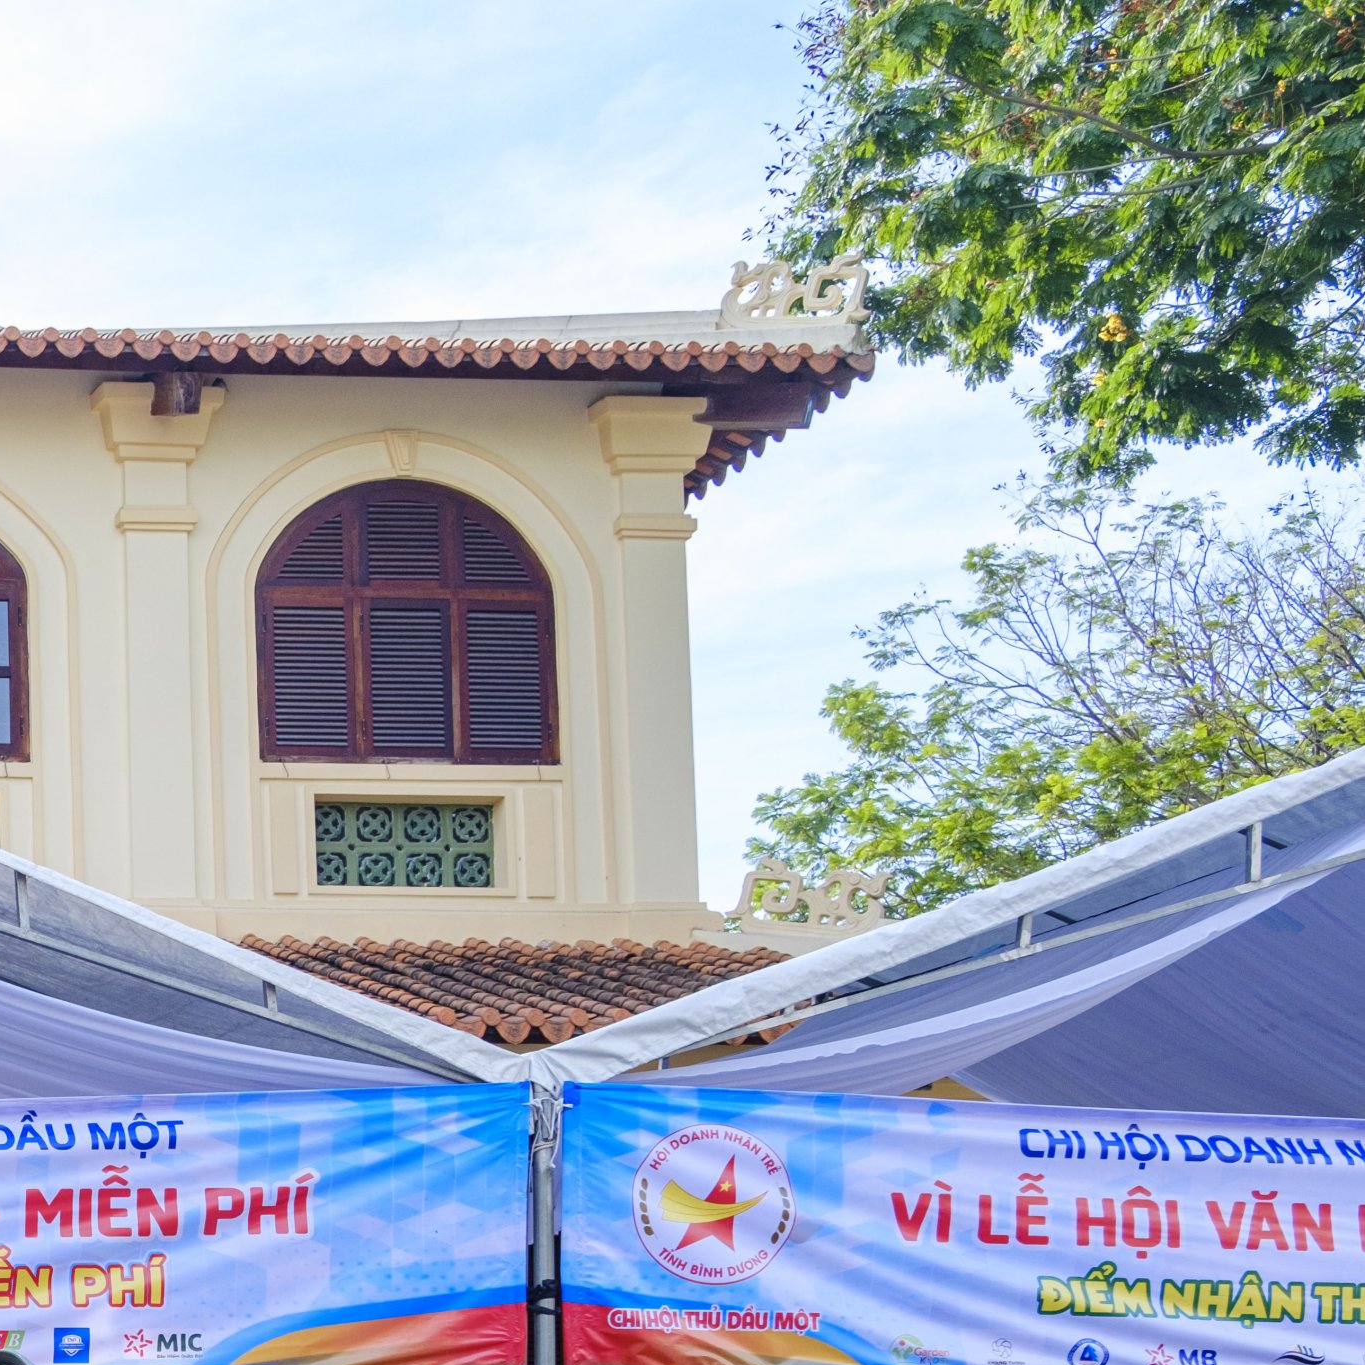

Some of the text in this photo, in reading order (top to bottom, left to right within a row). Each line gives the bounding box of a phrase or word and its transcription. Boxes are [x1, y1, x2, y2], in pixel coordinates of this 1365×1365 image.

[90, 1113, 184, 1159] MỘT
[649, 1128, 784, 1178] HỘI DOANH NHÂN TRẺ
[1020, 1127, 1086, 1160] CHI
[1094, 1123, 1170, 1170] HỘI
[1184, 1133, 1333, 1166] DOANH
[25, 1165, 179, 1238] MIỄN
[203, 1172, 316, 1236] PHÍ
[891, 1180, 953, 1243] VÌ
[977, 1173, 1050, 1246] LỄ
[1076, 1186, 1181, 1260] HỘI
[1206, 1190, 1335, 1252] VĂN
[70, 1252, 168, 1310] PHÍ
[658, 1246, 770, 1280] TỈNH BÌNH DƯƠNG
[1037, 1260, 1365, 1329] ĐIỂM NHẬN TH
[156, 1333, 203, 1352] MIC
[608, 1303, 822, 1335] CHI HỘI THỦ DẦU MỘT
